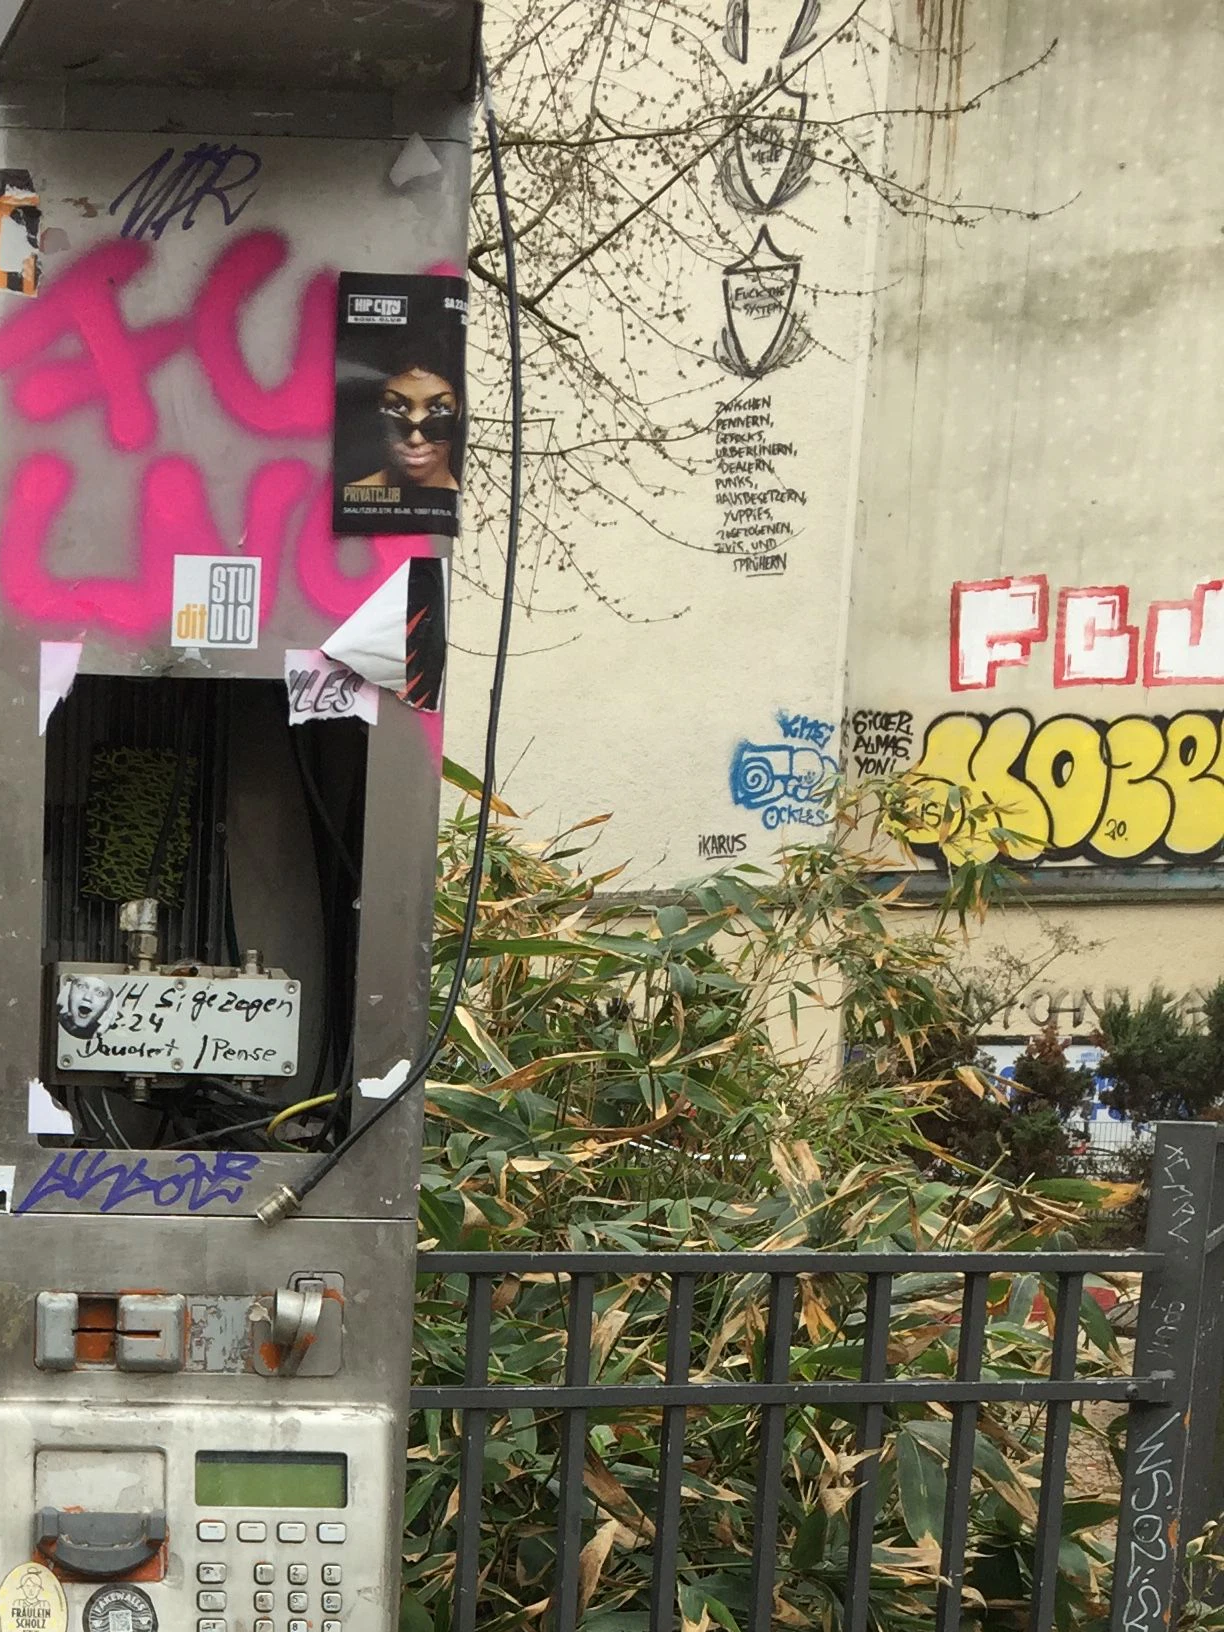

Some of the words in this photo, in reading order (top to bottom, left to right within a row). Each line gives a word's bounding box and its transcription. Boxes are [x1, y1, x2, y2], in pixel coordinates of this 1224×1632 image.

[716, 413, 774, 430] PENNERN,
[715, 476, 758, 490] PUNKS,
[344, 486, 401, 502] PRIVATCLUB
[212, 566, 253, 603] STU
[176, 603, 207, 640] dit
[209, 604, 251, 641] DIO
[16, 1618, 46, 1629] SCHOLZ
